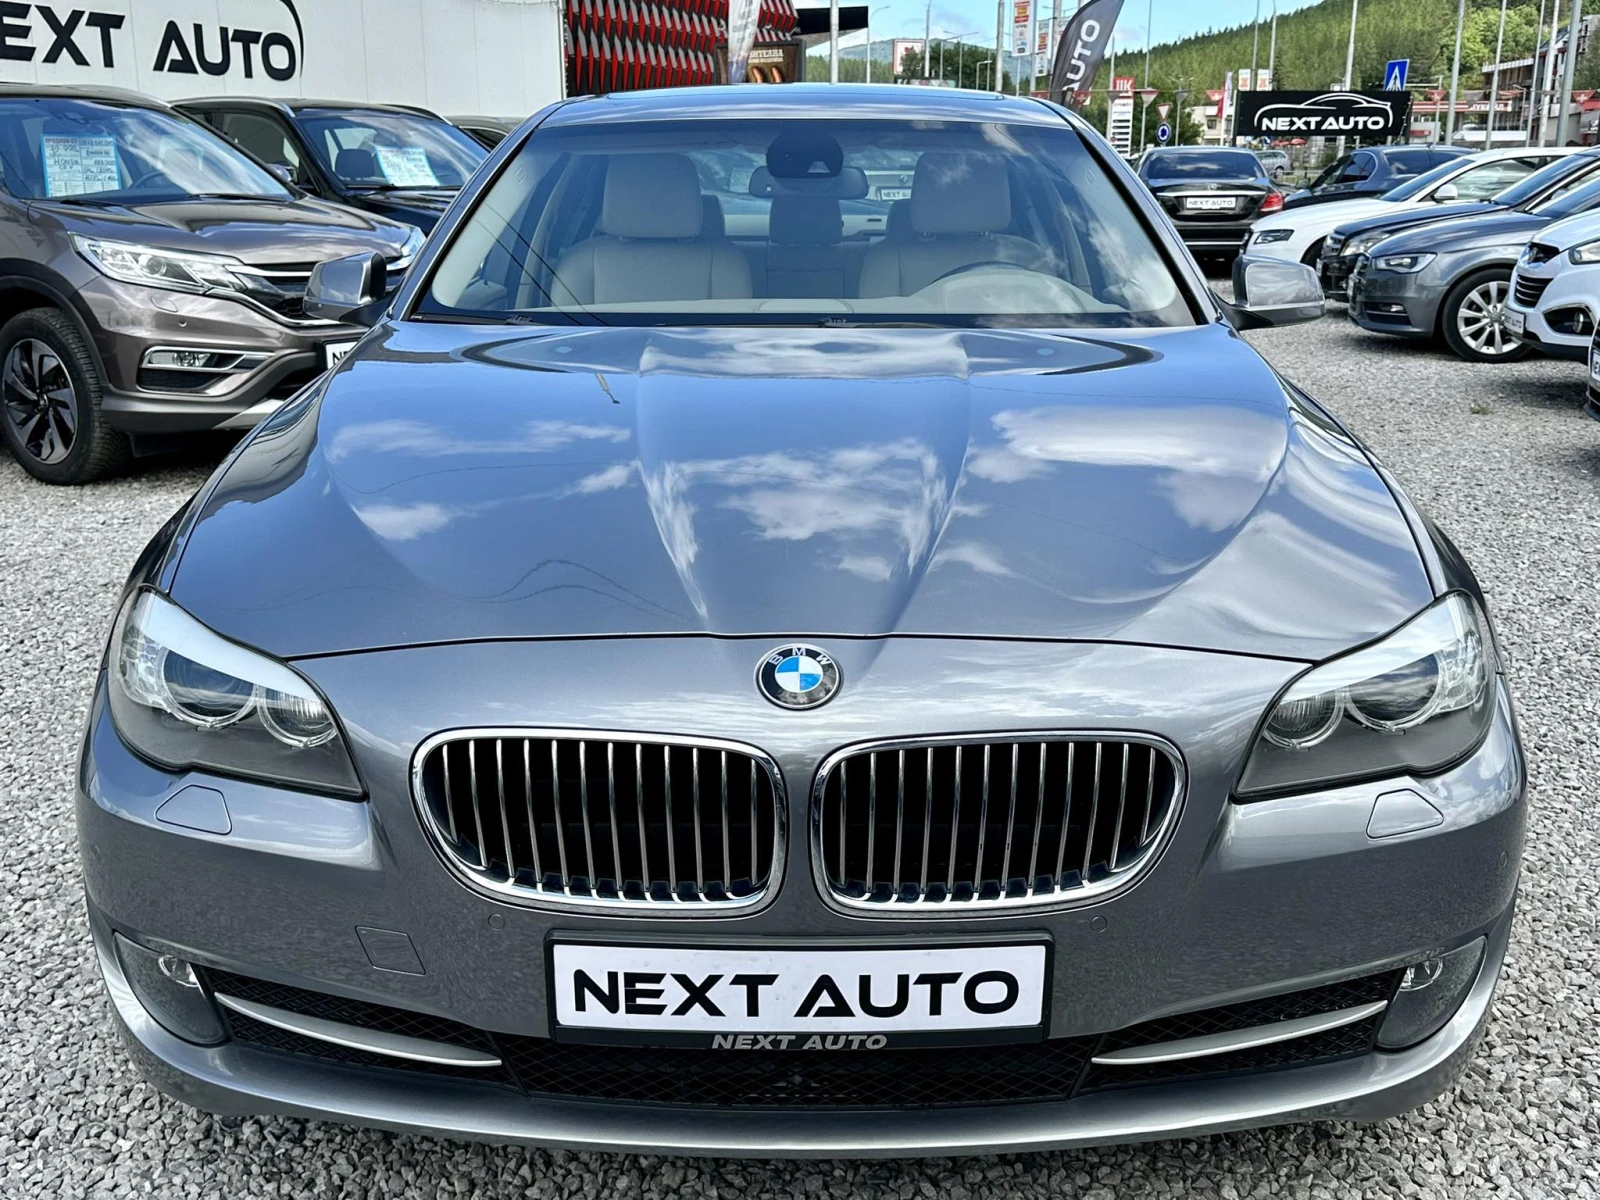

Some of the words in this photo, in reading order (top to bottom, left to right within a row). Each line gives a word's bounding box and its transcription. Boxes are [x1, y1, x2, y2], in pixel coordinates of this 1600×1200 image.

[152, 20, 297, 82] AUTO
[1261, 117, 1322, 131] NEXT
[1320, 116, 1385, 130] AUTO
[768, 647, 832, 666] BMW
[573, 969, 780, 1018] NEXT
[793, 970, 1020, 1018] AUTO
[711, 1034, 797, 1050] NEXT
[801, 1034, 888, 1050] AUTO
